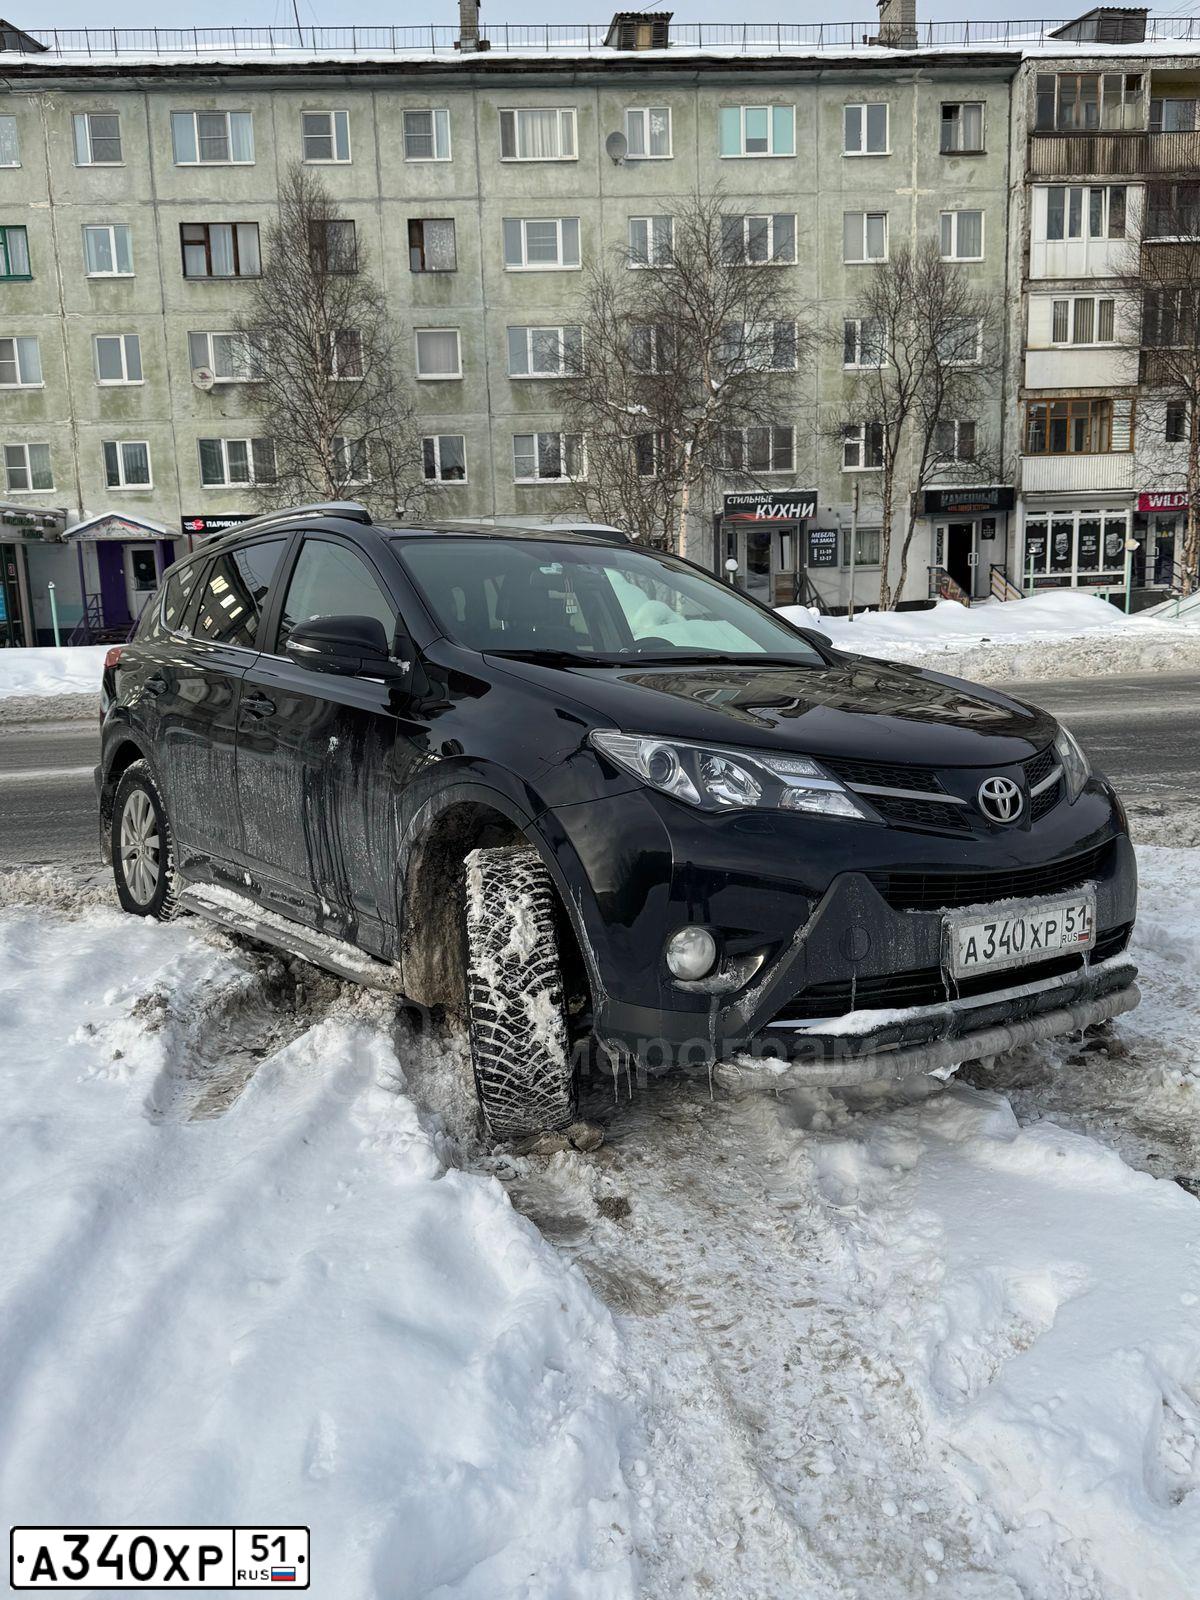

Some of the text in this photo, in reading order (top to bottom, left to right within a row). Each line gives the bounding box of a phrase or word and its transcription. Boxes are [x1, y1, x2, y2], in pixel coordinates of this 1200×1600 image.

[727, 495, 774, 504] СТИЛЬНЫЕ
[756, 503, 815, 519] КУХНИ
[1065, 904, 1088, 933] 51
[964, 918, 1057, 965] А340ХР
[1061, 931, 1079, 944] RUS
